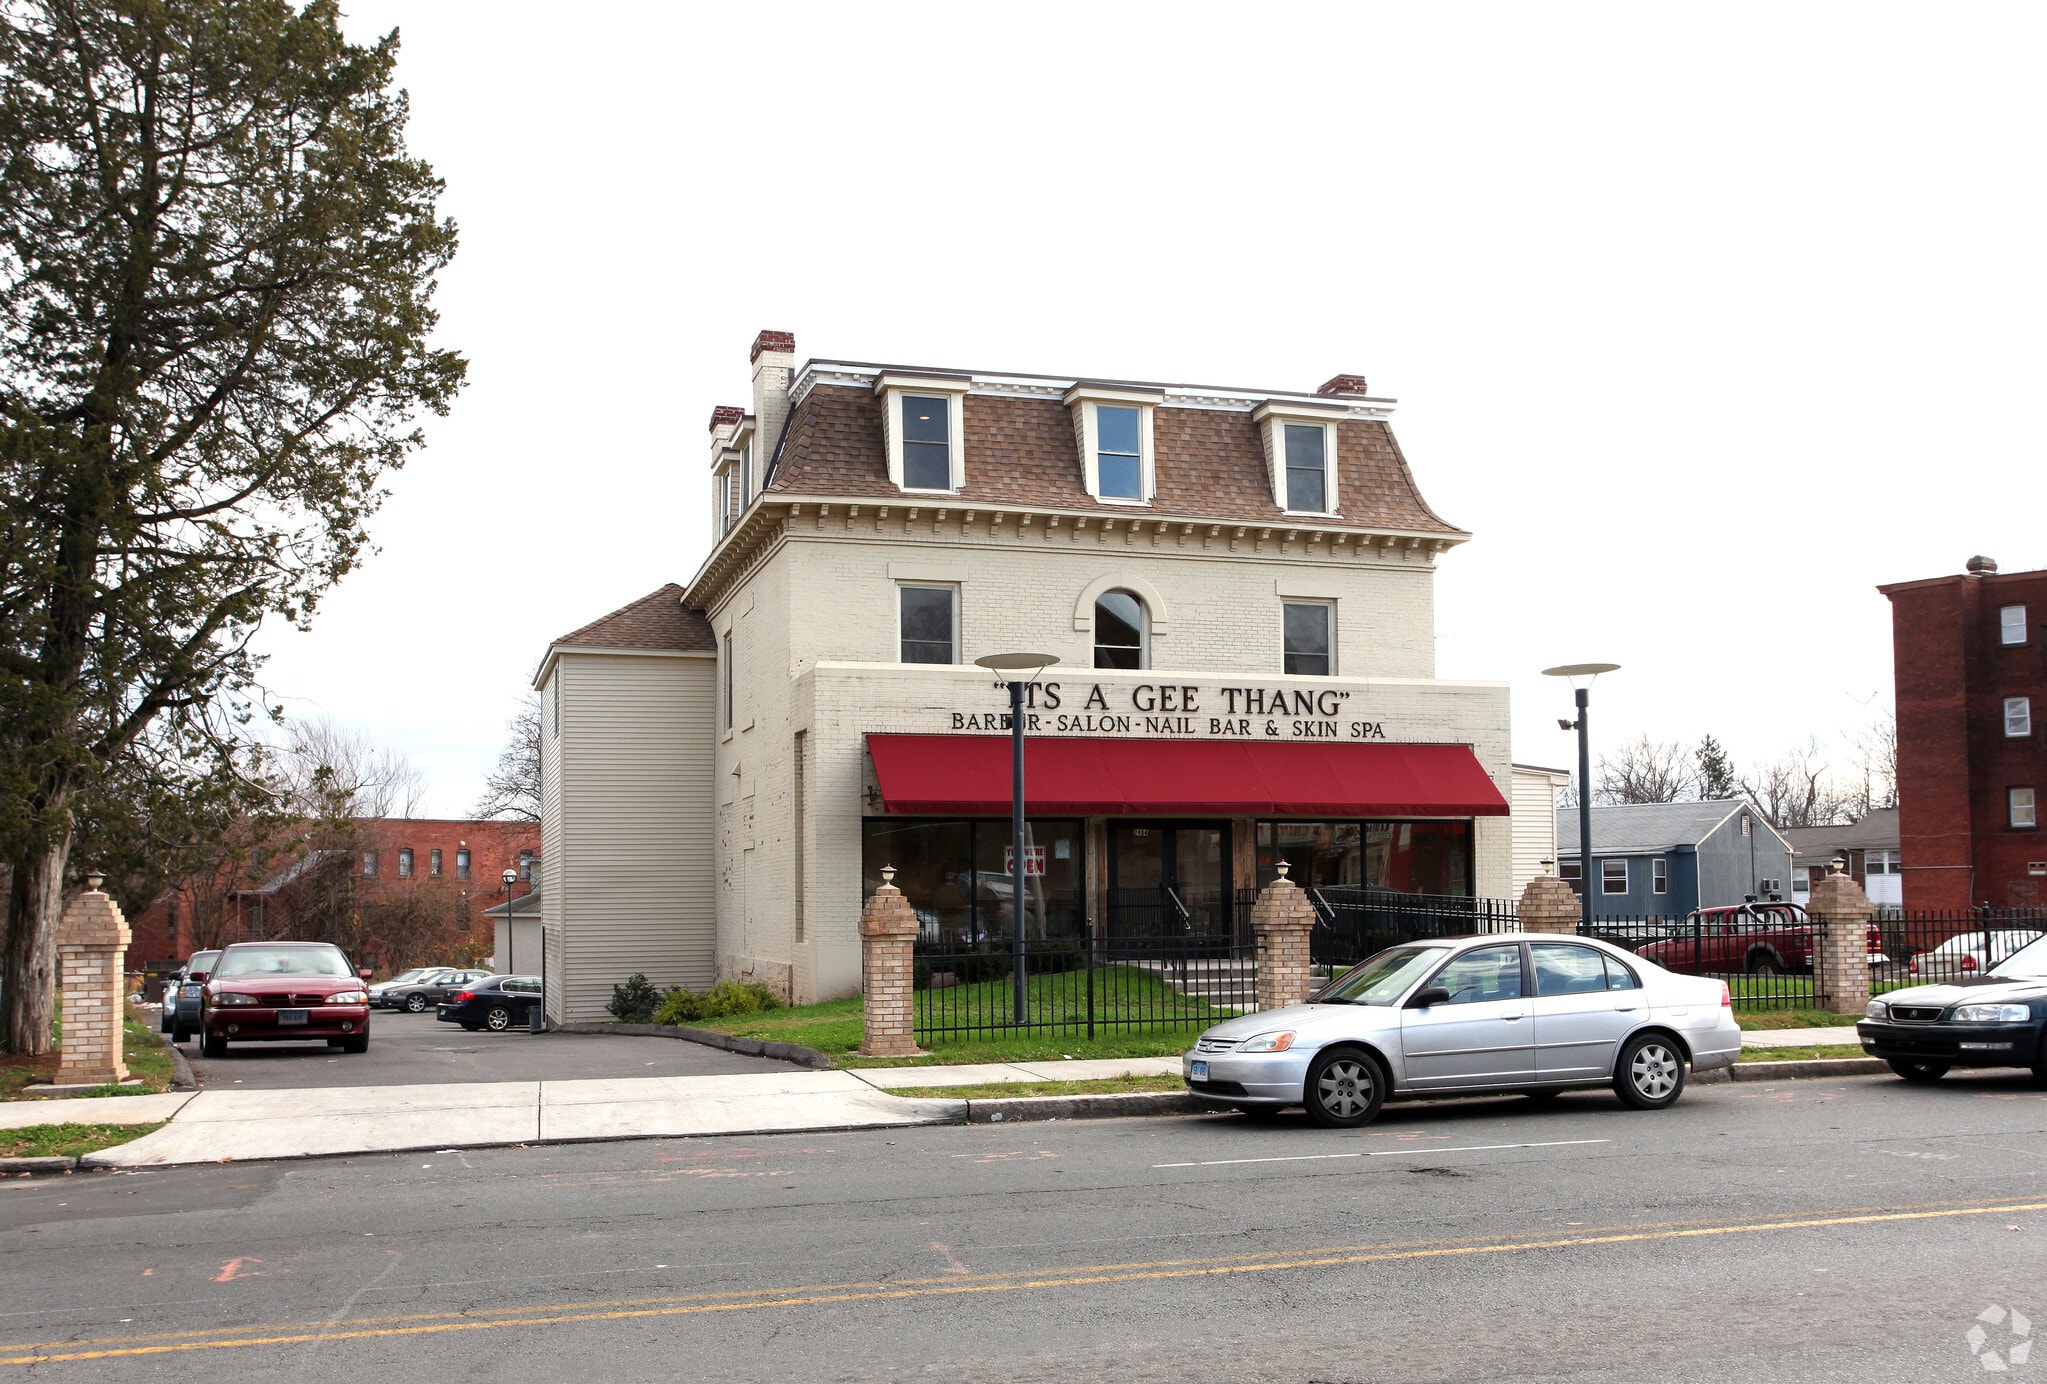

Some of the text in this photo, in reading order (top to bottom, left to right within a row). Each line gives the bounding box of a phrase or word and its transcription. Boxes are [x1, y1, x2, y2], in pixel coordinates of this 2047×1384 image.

[994, 681, 1351, 717] “TS A GEE THANG”
[1209, 718, 1252, 736] BAR
[1265, 719, 1280, 736] &
[1292, 720, 1338, 737] SKIN
[1350, 722, 1386, 739] SPA
[1007, 858, 1044, 874] OEN
